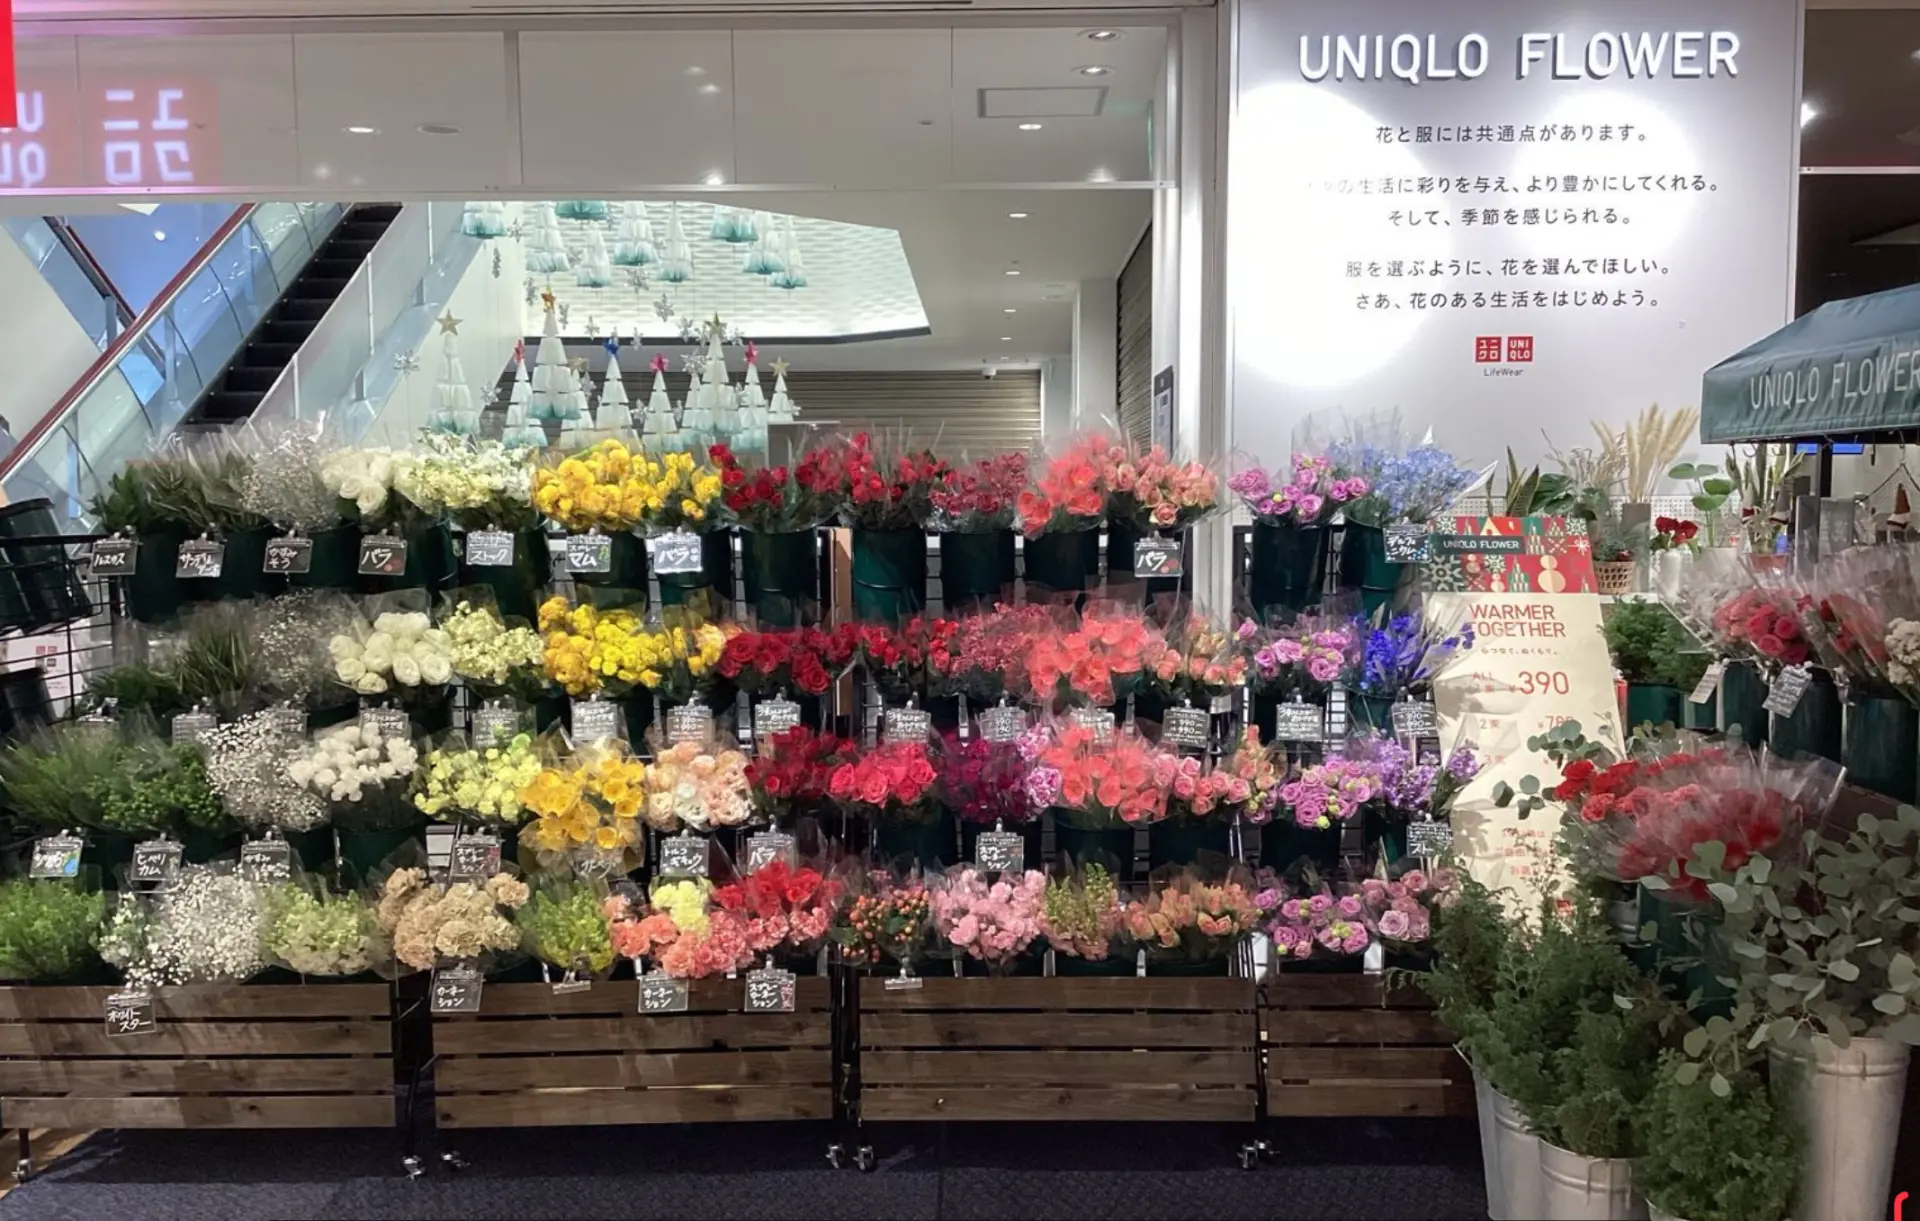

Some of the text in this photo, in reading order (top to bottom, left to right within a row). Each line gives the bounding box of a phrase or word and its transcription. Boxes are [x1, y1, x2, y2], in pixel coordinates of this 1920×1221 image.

[1299, 31, 1741, 83] UNIQLO FLOWER
[1375, 123, 1649, 145] 花と服には共通点があります。
[1306, 173, 1719, 196] の生活に彩りを与え、より豊かにしてくれる。
[1387, 206, 1632, 228] そして、季節を感じられる。
[1345, 257, 1671, 279] 服を選ぶように、花を選んでほしい。
[1356, 290, 1661, 311] さあ、花のある生活をはじめよう。
[1509, 339, 1530, 349] UNI
[1509, 350, 1531, 360] QLO
[1483, 368, 1524, 376] LifeWear
[1750, 350, 1920, 410] UNIQLO FLOWER
[1442, 539, 1520, 549] UNIQLO FLOWER
[360, 548, 393, 569] バラ
[470, 550, 508, 562] ストック
[568, 552, 598, 568] マム
[658, 546, 690, 566] バラ
[1136, 550, 1168, 572] バラ
[1469, 604, 1556, 620] WARMER
[664, 848, 688, 856] トルコ
[750, 846, 776, 869] バラ
[138, 864, 161, 876] カム
[436, 985, 466, 997] カーネー
[643, 988, 673, 998] カーネー
[438, 998, 465, 1008] ション
[644, 998, 672, 1009] ション
[120, 1018, 152, 1032] スター
